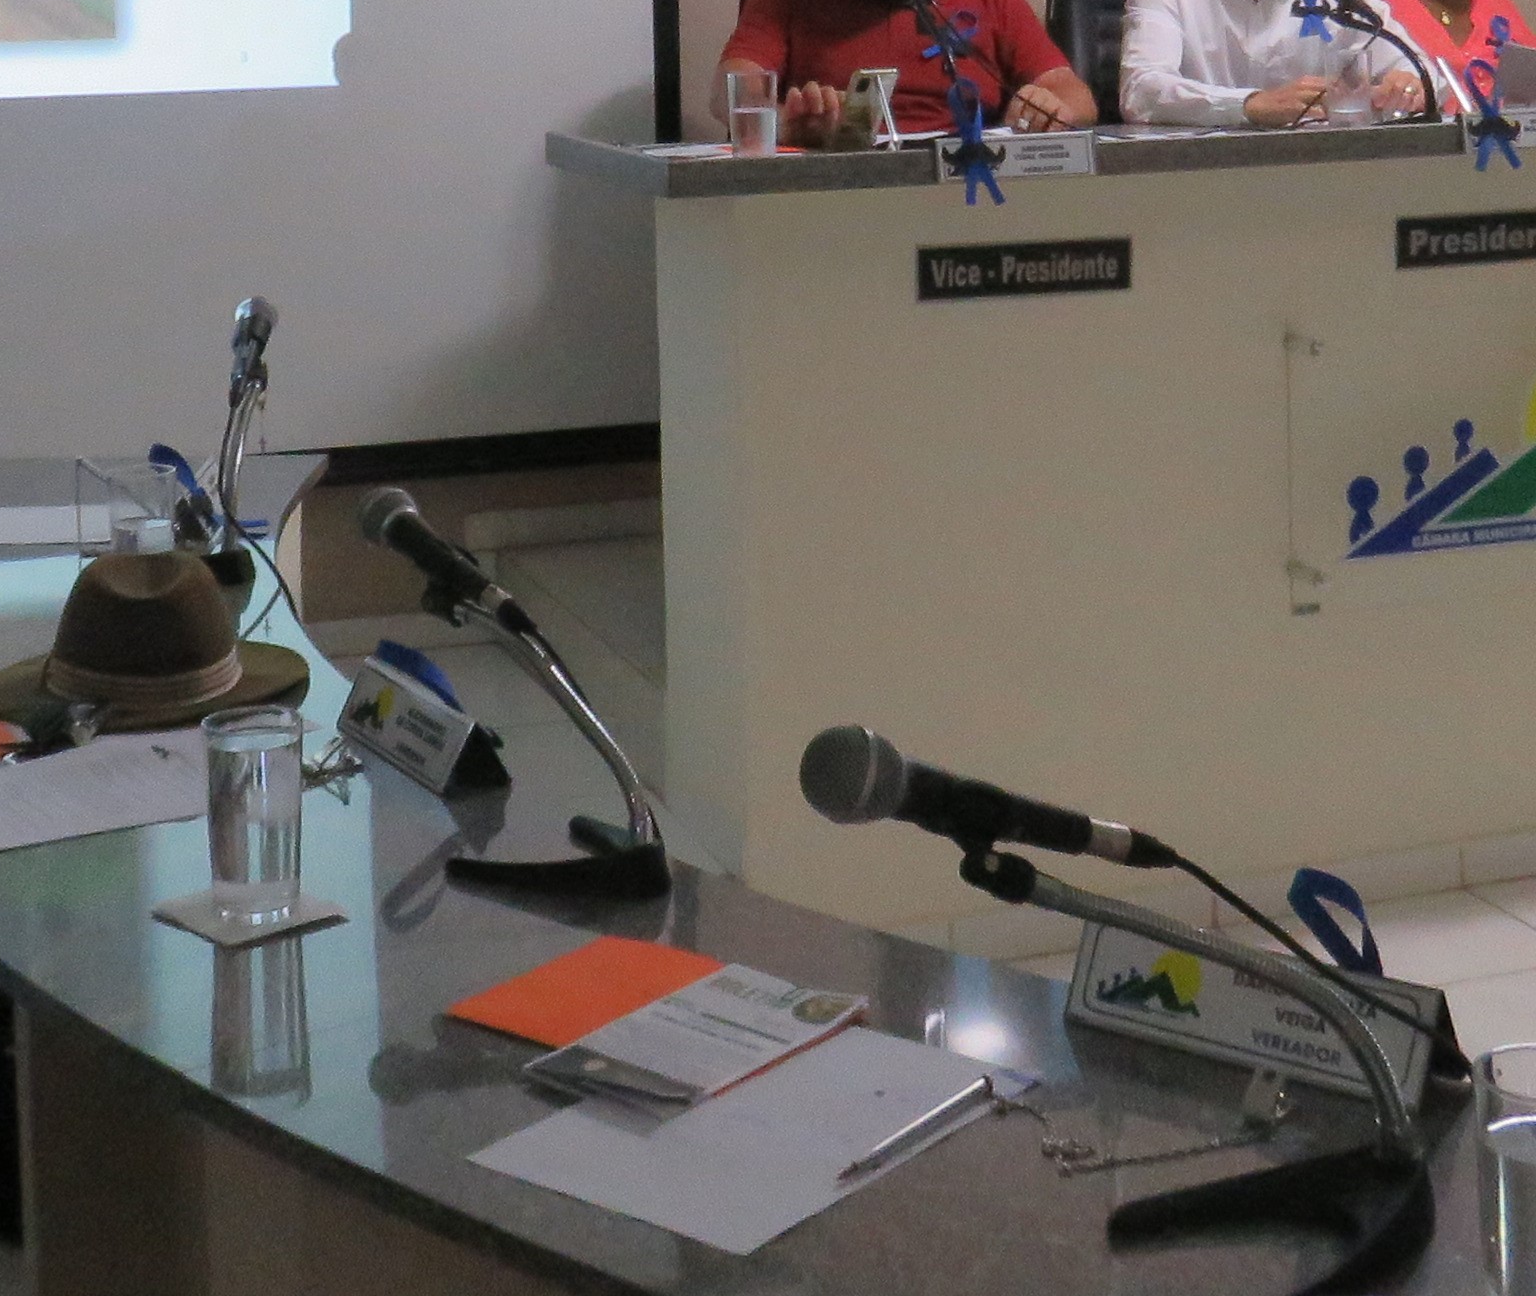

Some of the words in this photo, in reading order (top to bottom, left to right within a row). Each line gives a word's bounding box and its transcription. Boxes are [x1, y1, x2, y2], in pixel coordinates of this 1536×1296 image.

[930, 257, 982, 289] Vice
[1002, 254, 1119, 284] Presidente
[1251, 1027, 1342, 1066] VEREADOR
